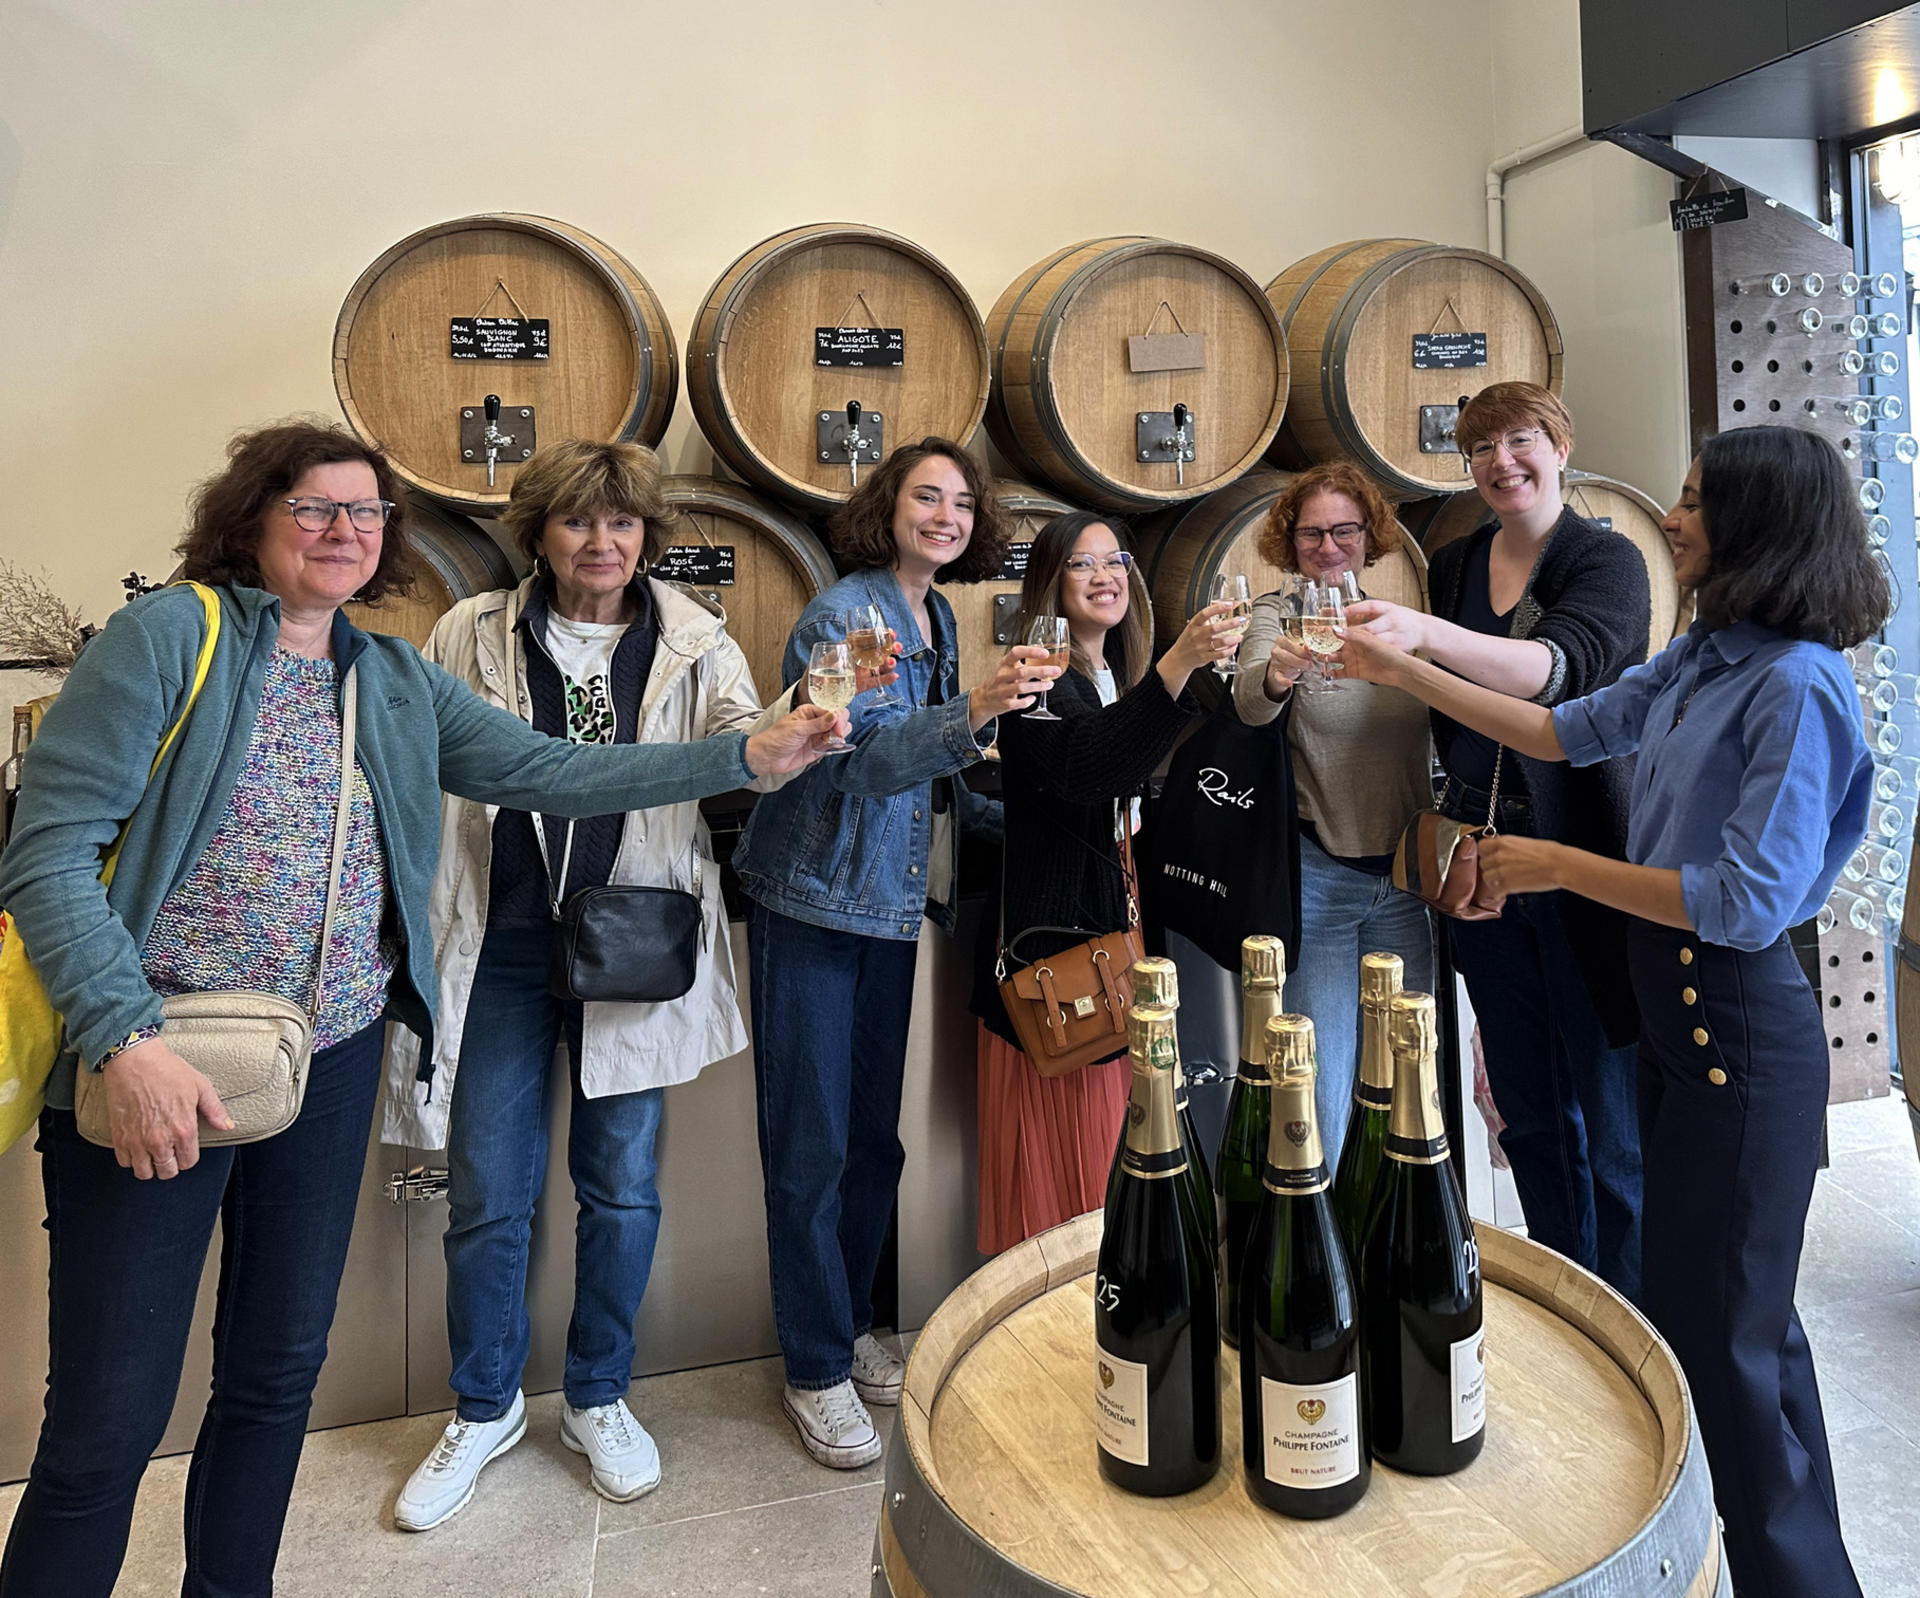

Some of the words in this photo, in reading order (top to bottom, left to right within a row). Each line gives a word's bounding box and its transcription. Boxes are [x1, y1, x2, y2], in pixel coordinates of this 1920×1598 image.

[1198, 767, 1255, 809] Rails
[1163, 863, 1205, 886] NOTTING
[1209, 879, 1228, 898] HILL
[1097, 1274, 1121, 1312] 25
[1104, 1405, 1137, 1427] FONTAINE
[1272, 1436, 1309, 1451] PHILIPPE
[1310, 1433, 1350, 1451] FONTAINE
[1284, 1428, 1339, 1440] CHAMPAGNE
[1290, 1467, 1309, 1475] BRUT
[1310, 1465, 1337, 1475] NATURE
